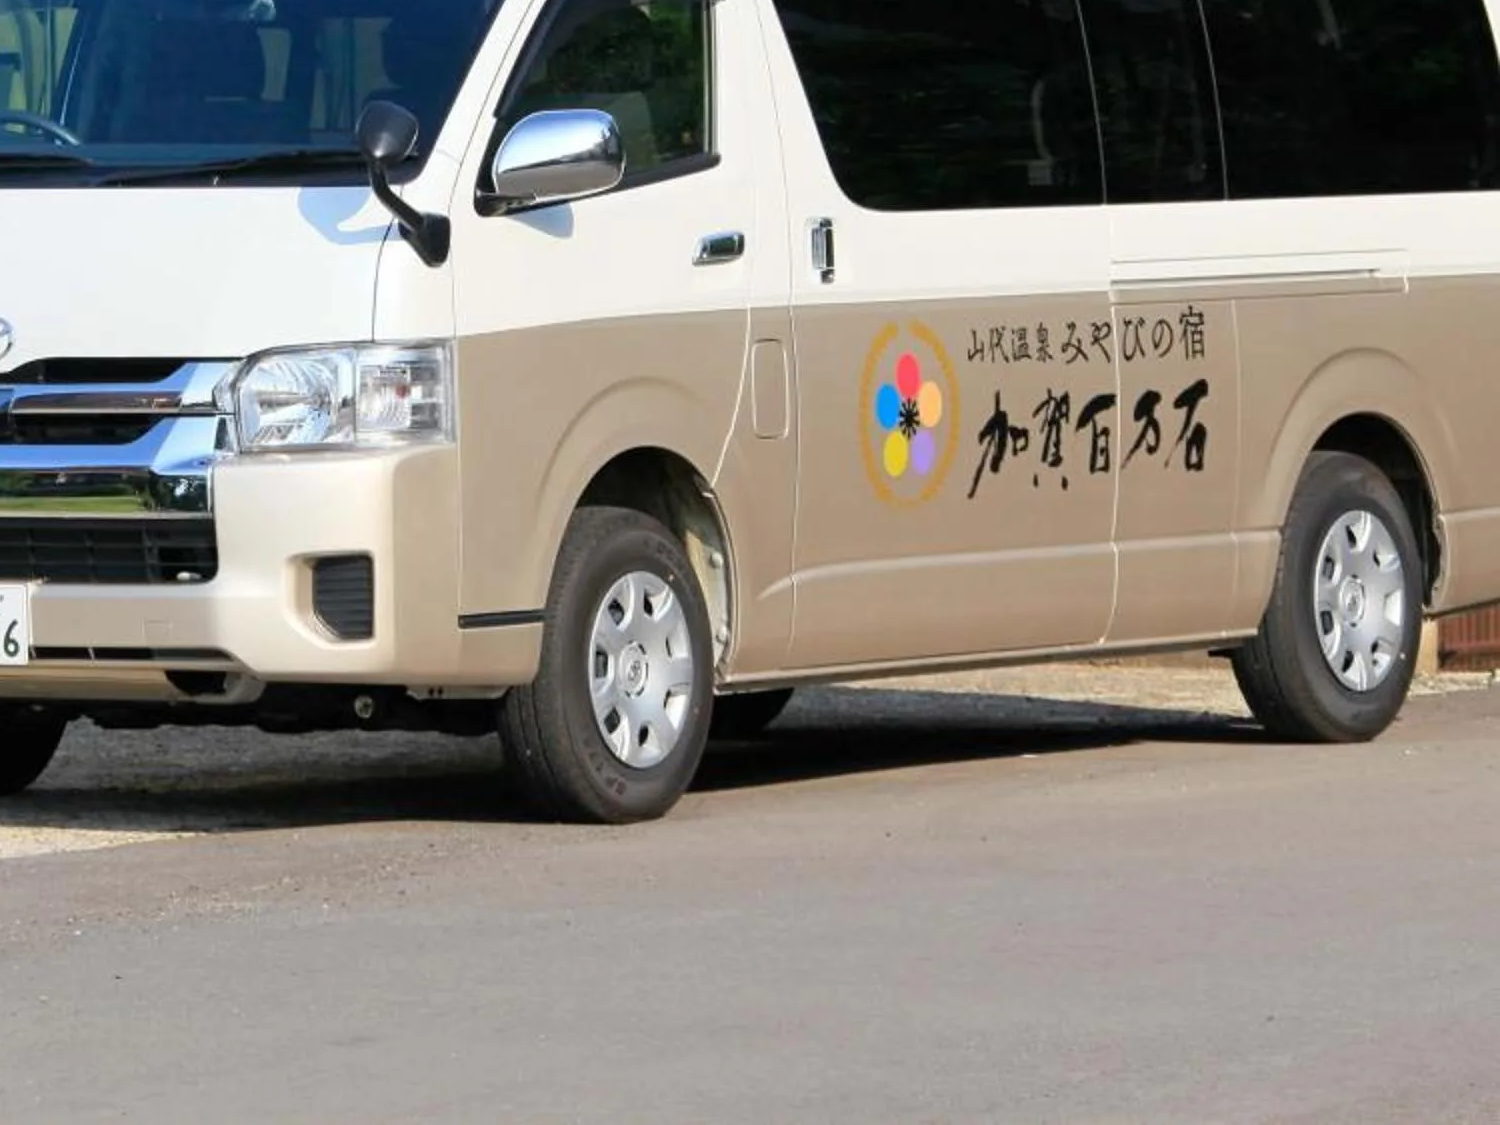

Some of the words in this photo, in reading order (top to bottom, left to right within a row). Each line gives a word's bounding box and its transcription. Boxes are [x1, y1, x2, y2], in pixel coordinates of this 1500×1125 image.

[966, 378, 1209, 500] 加賀百万石
